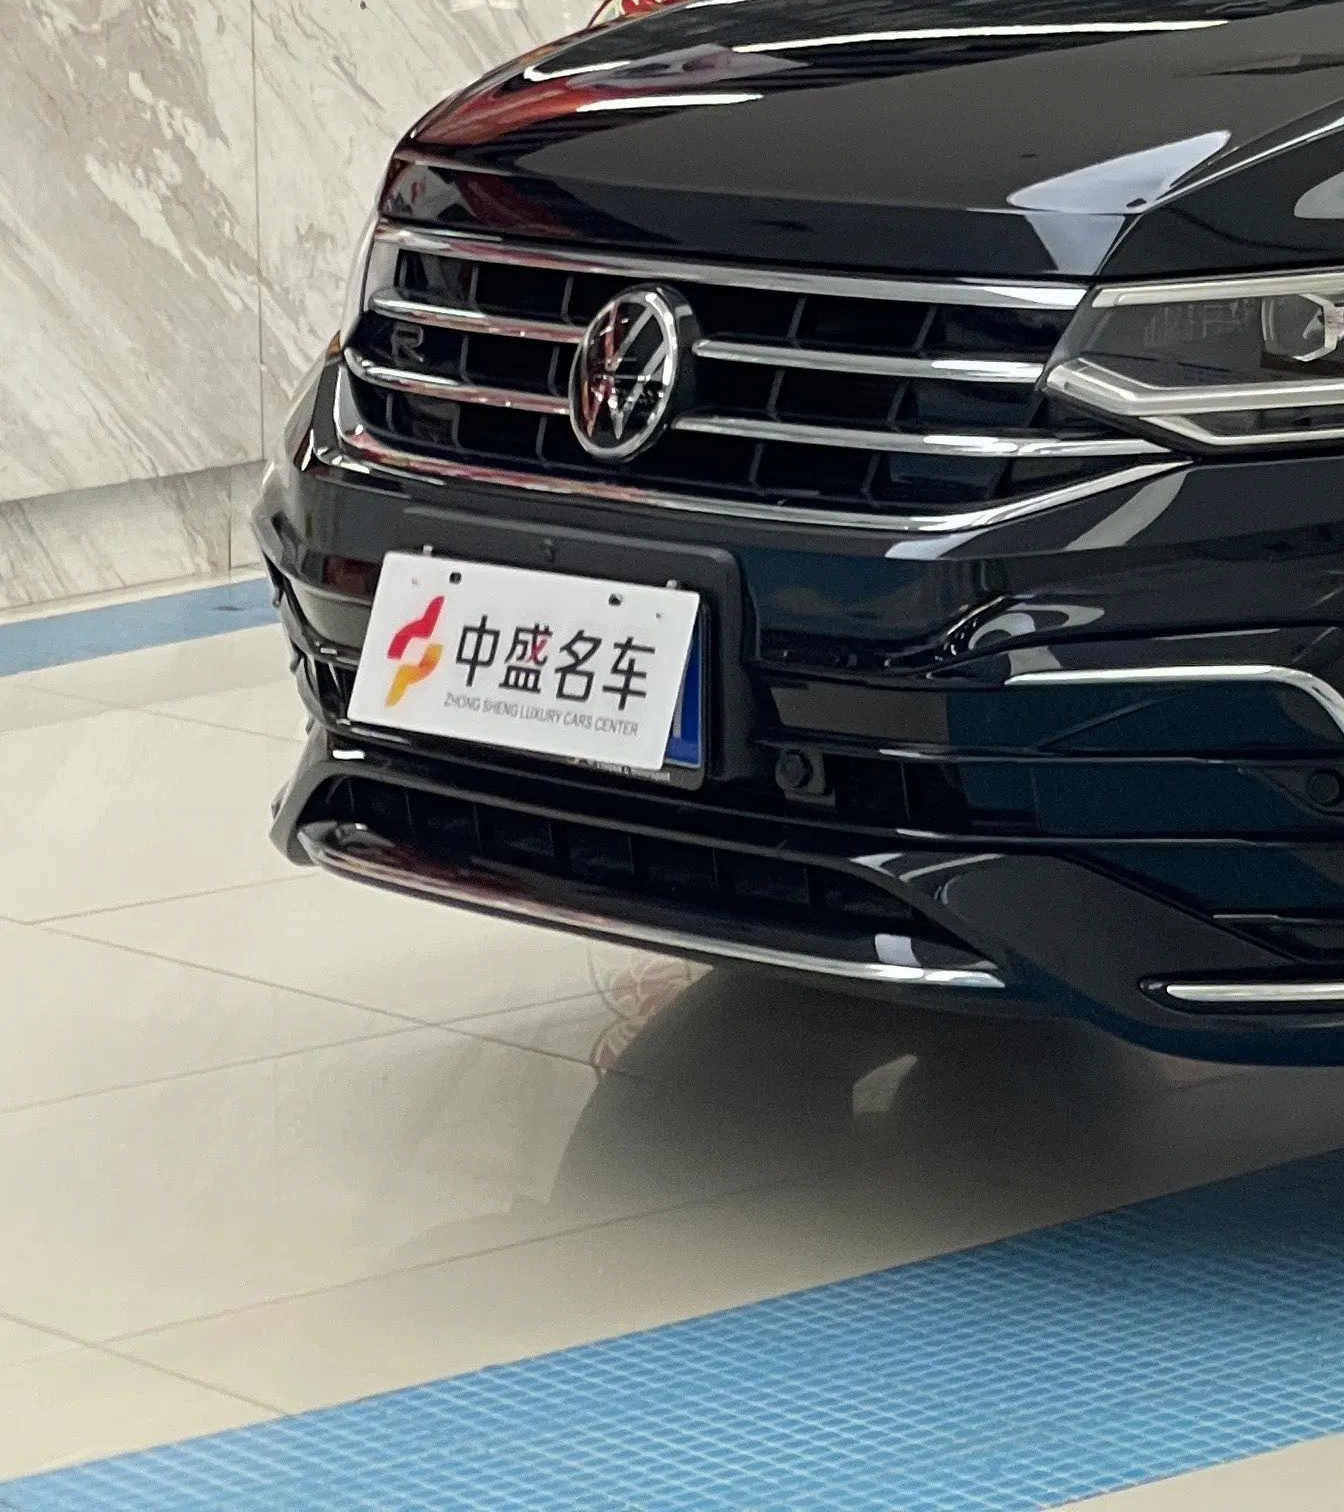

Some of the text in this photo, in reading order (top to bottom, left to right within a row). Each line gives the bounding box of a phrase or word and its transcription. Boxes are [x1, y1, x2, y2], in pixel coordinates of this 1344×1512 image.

[455, 614, 656, 711] 中盛名车
[443, 692, 639, 738] ZHONG SHENG LUXURY CARS CENTER
